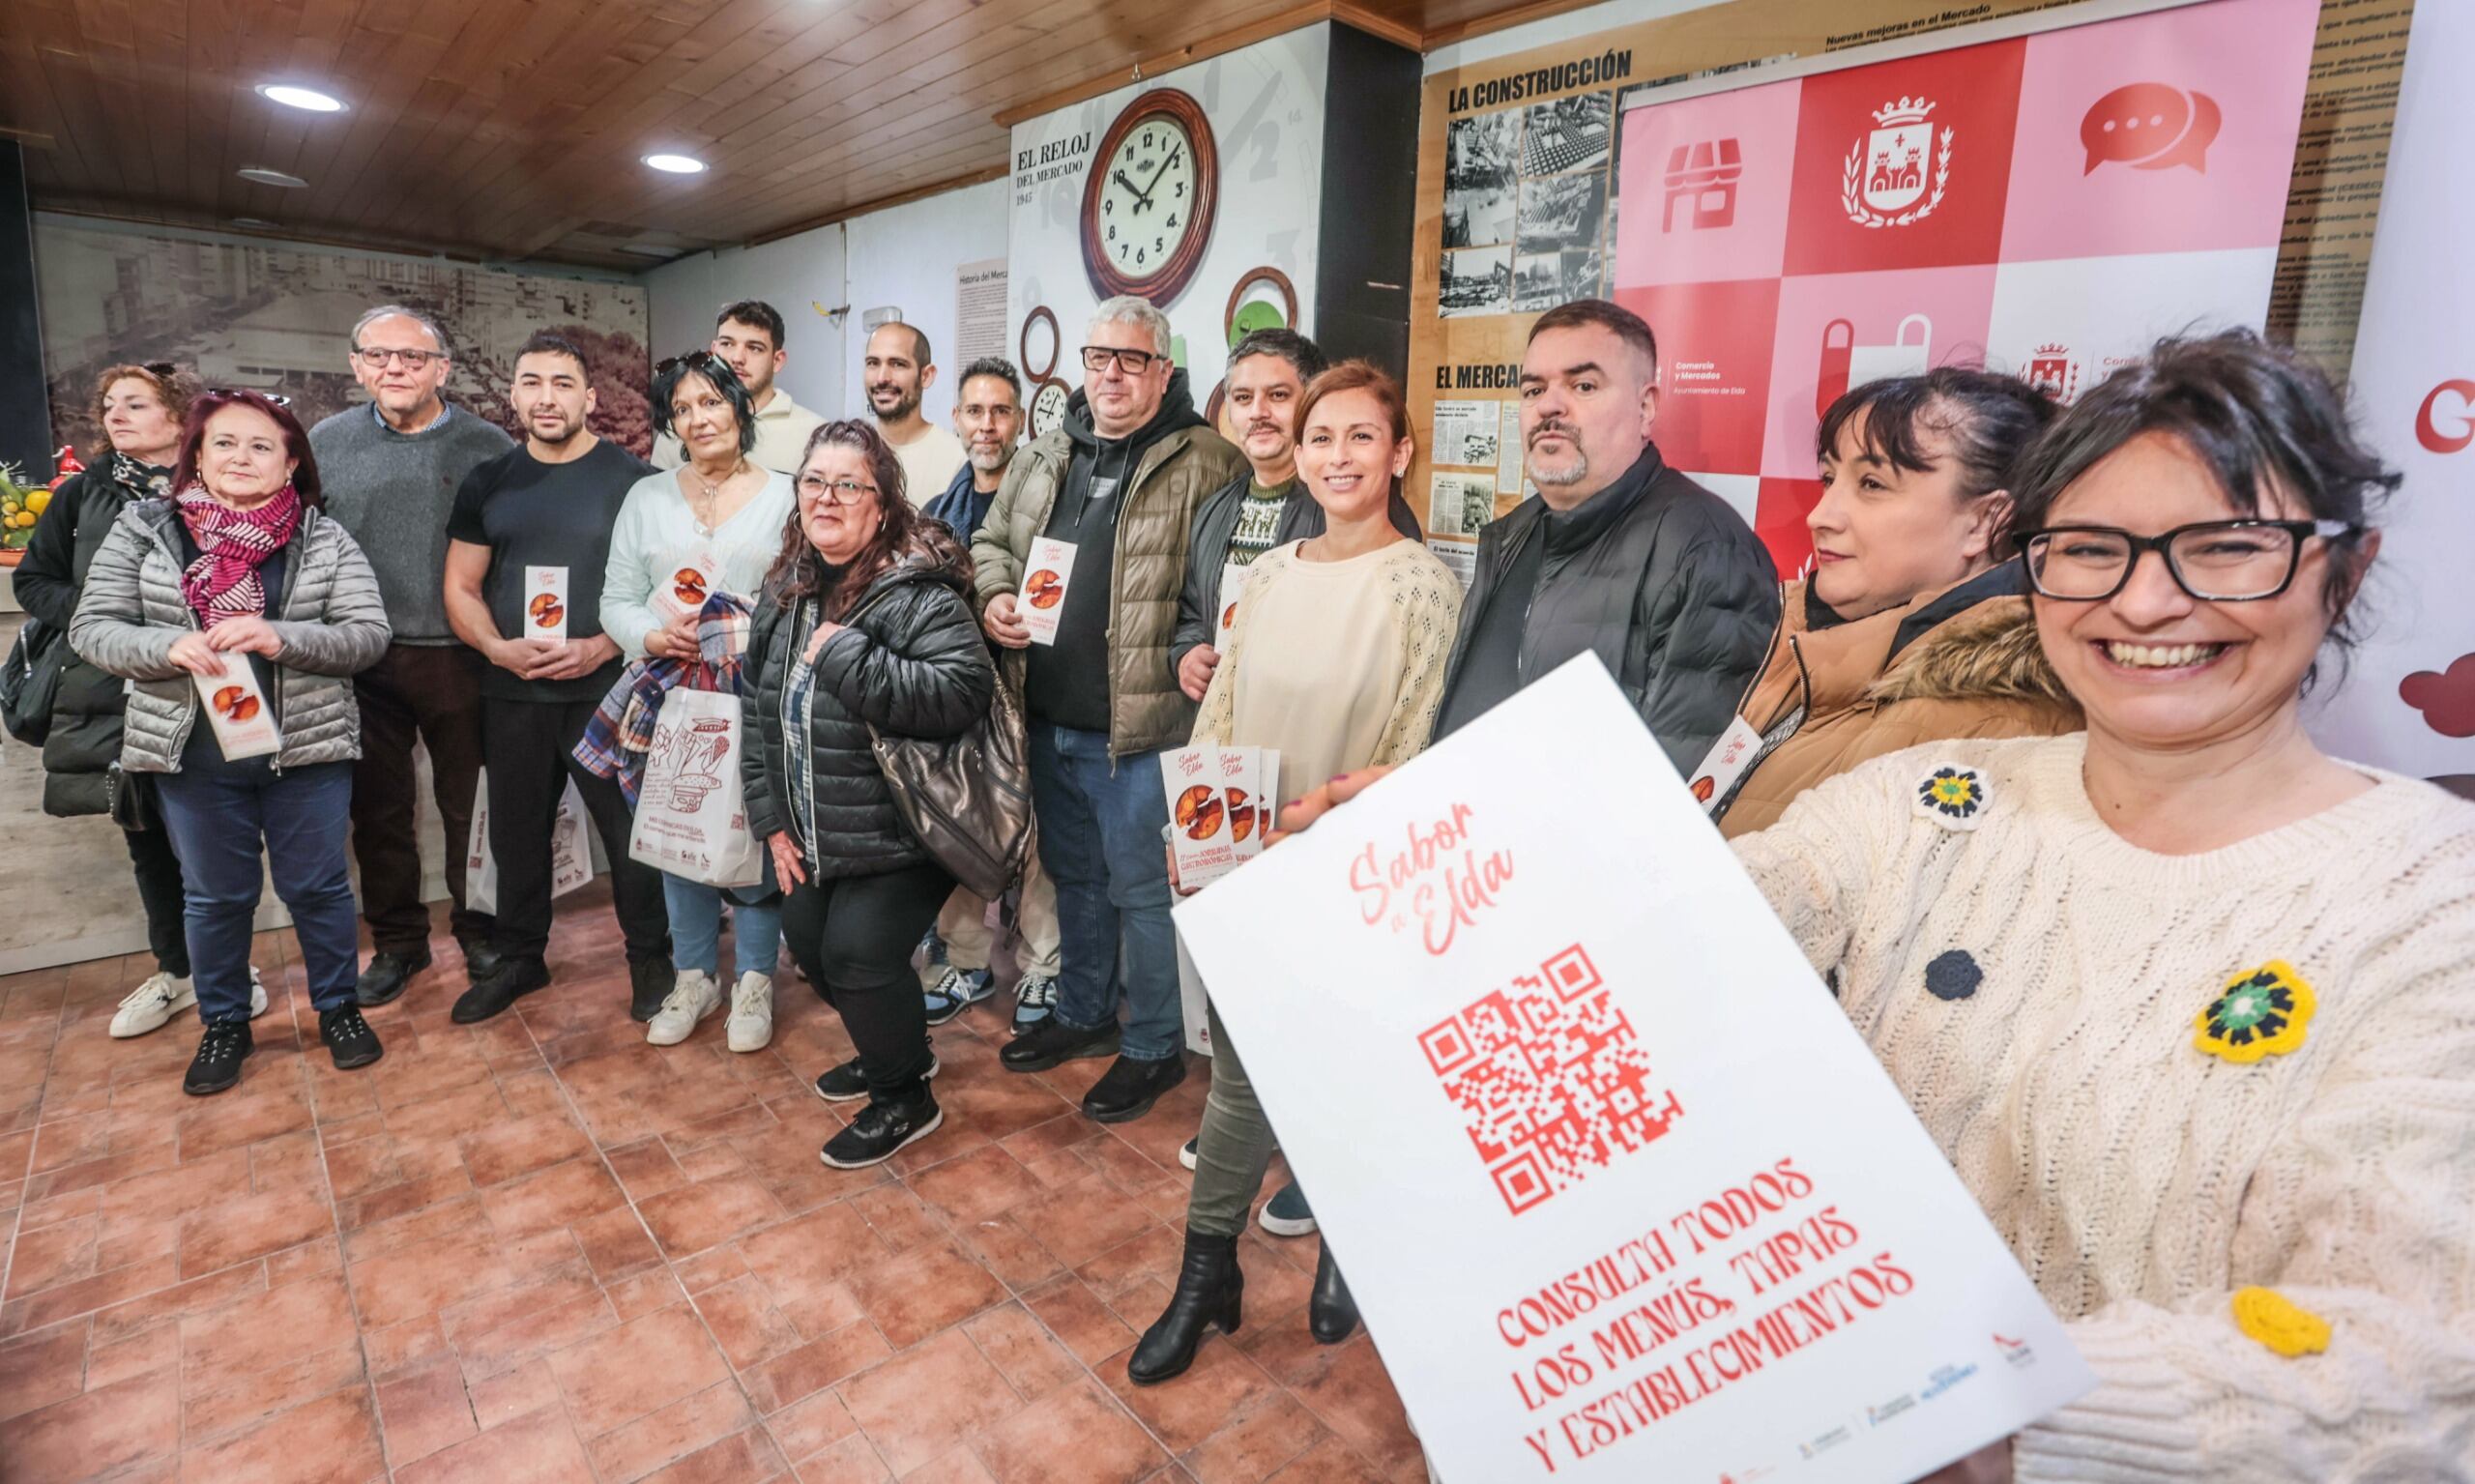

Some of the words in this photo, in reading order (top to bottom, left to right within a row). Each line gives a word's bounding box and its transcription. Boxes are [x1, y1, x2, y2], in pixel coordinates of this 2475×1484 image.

[1826, 31, 1864, 45] Nuevas
[1867, 20, 1908, 38] mejoras
[1929, 15, 1938, 25] el
[1941, 4, 1991, 21] Mercado
[1448, 87, 1470, 113] LA
[1472, 47, 1632, 109] CONSTRUCCIÓN
[1143, 132, 1153, 148] 12
[1161, 136, 1167, 152] 1
[1017, 151, 1037, 171] EL
[1040, 131, 1092, 164] RELOJ
[1126, 146, 1134, 161] 11
[1173, 154, 1180, 170] 2
[1016, 174, 1035, 189] DEL
[1036, 160, 1083, 183] MERCADO
[1113, 169, 1125, 185] 10
[1176, 182, 1183, 197] 3
[1016, 191, 1033, 206] 1945
[1105, 199, 1113, 216] 9
[1166, 213, 1177, 227] 4
[1108, 225, 1116, 240] 8
[1121, 245, 1129, 259] 7
[1155, 238, 1163, 252] 5
[1137, 247, 1145, 264] 6
[960, 273, 979, 284] Historia
[980, 271, 990, 280] del
[1675, 361, 1715, 369] Comercio
[1436, 365, 1452, 389] EL
[1456, 364, 1524, 389] MERCA
[1674, 372, 1680, 381] y
[1681, 371, 1721, 380] Mercados
[1674, 387, 1719, 395] Ayuntamiento
[1179, 752, 1200, 770] Sabor
[1220, 754, 1242, 767] Sabor
[1186, 762, 1203, 776] Elda
[1225, 764, 1243, 776] Elda
[1350, 803, 1473, 926] Sabor
[1391, 914, 1406, 933] a
[1413, 848, 1514, 956] Elda
[1498, 1229, 1676, 1348] CONSULTA
[1671, 1156, 1814, 1255] TODOS
[1512, 1343, 1594, 1411] LOS
[1591, 1277, 1737, 1371] MENÚS,
[1729, 1206, 1859, 1295] TAPAS
[1525, 1427, 1556, 1473] Y
[1559, 1251, 1914, 1460] ESTABLECIMIENTOS
